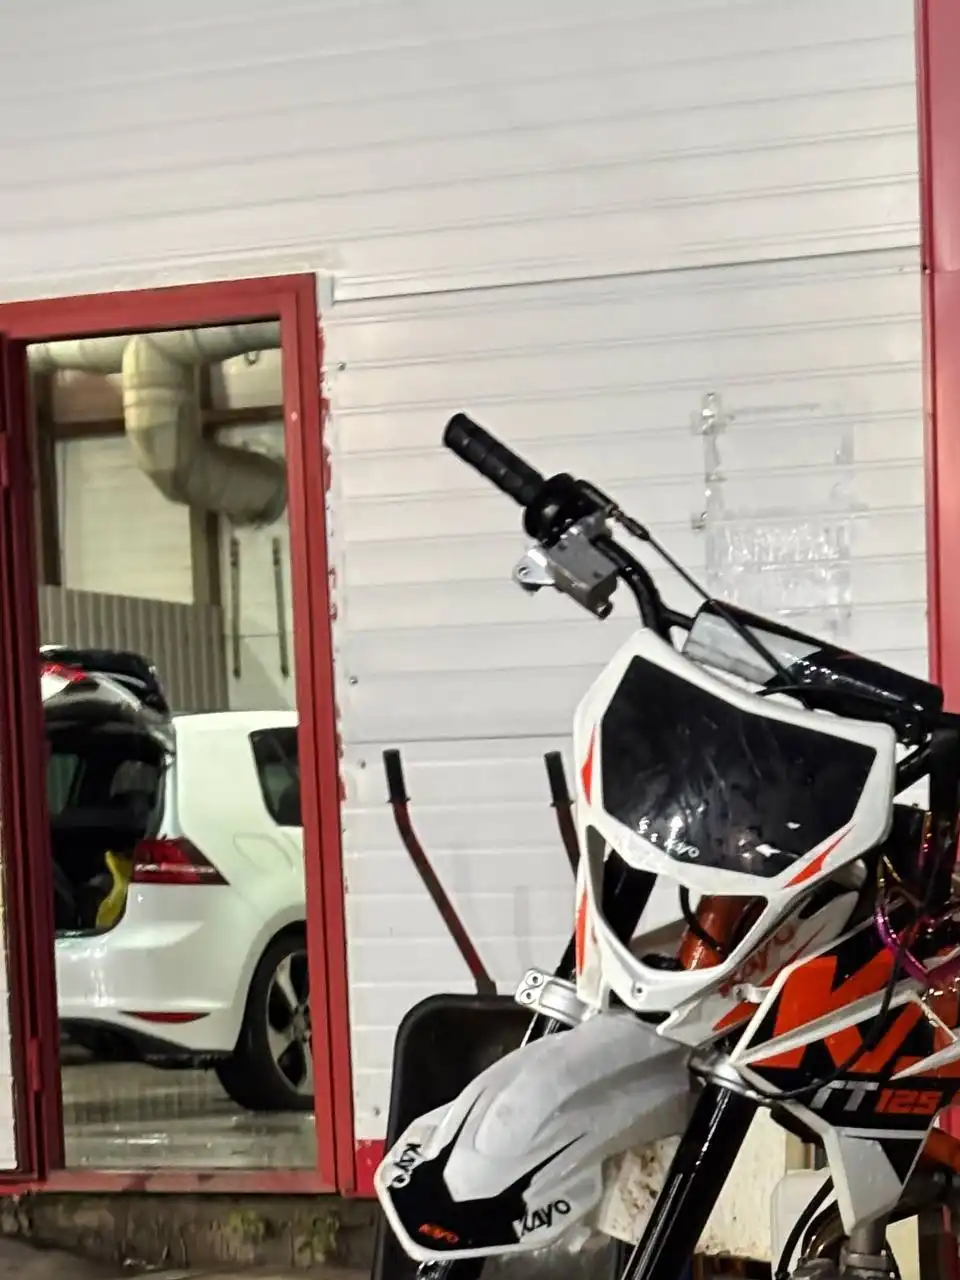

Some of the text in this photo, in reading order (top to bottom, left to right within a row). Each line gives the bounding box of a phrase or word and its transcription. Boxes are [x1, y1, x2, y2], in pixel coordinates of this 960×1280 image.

[873, 1088, 944, 1115] 125
[387, 1142, 422, 1189] KAYO
[513, 1199, 572, 1240] KAYO
